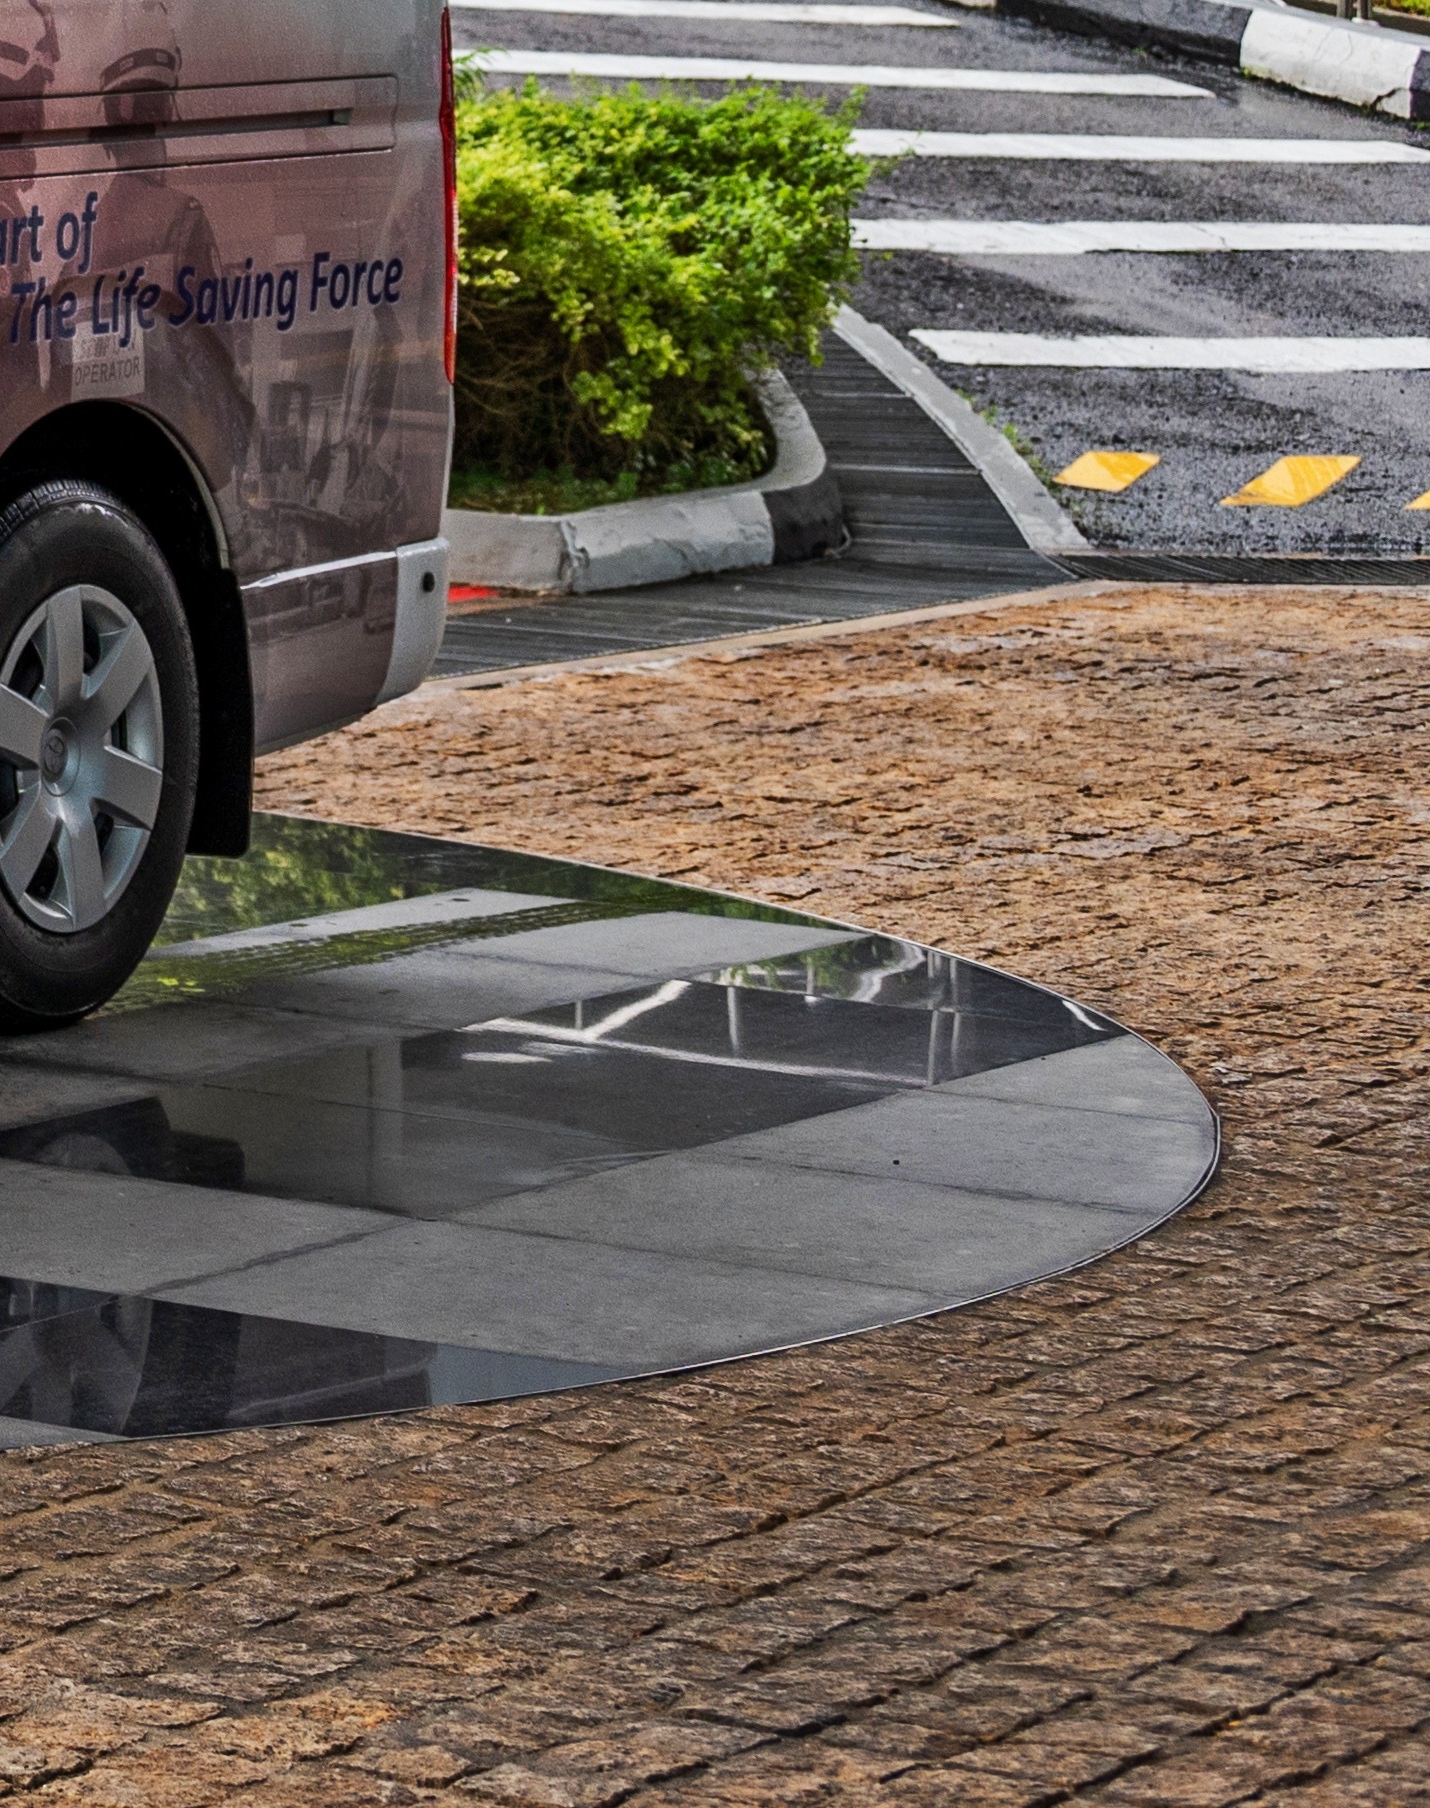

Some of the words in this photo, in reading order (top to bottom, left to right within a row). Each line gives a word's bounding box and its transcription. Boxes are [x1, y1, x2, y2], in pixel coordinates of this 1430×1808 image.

[55, 191, 100, 274] of
[8, 274, 78, 345] The
[91, 270, 162, 349] Life
[169, 265, 297, 333] Saving
[309, 251, 404, 311] Force
[74, 355, 141, 387] OPERATOR
